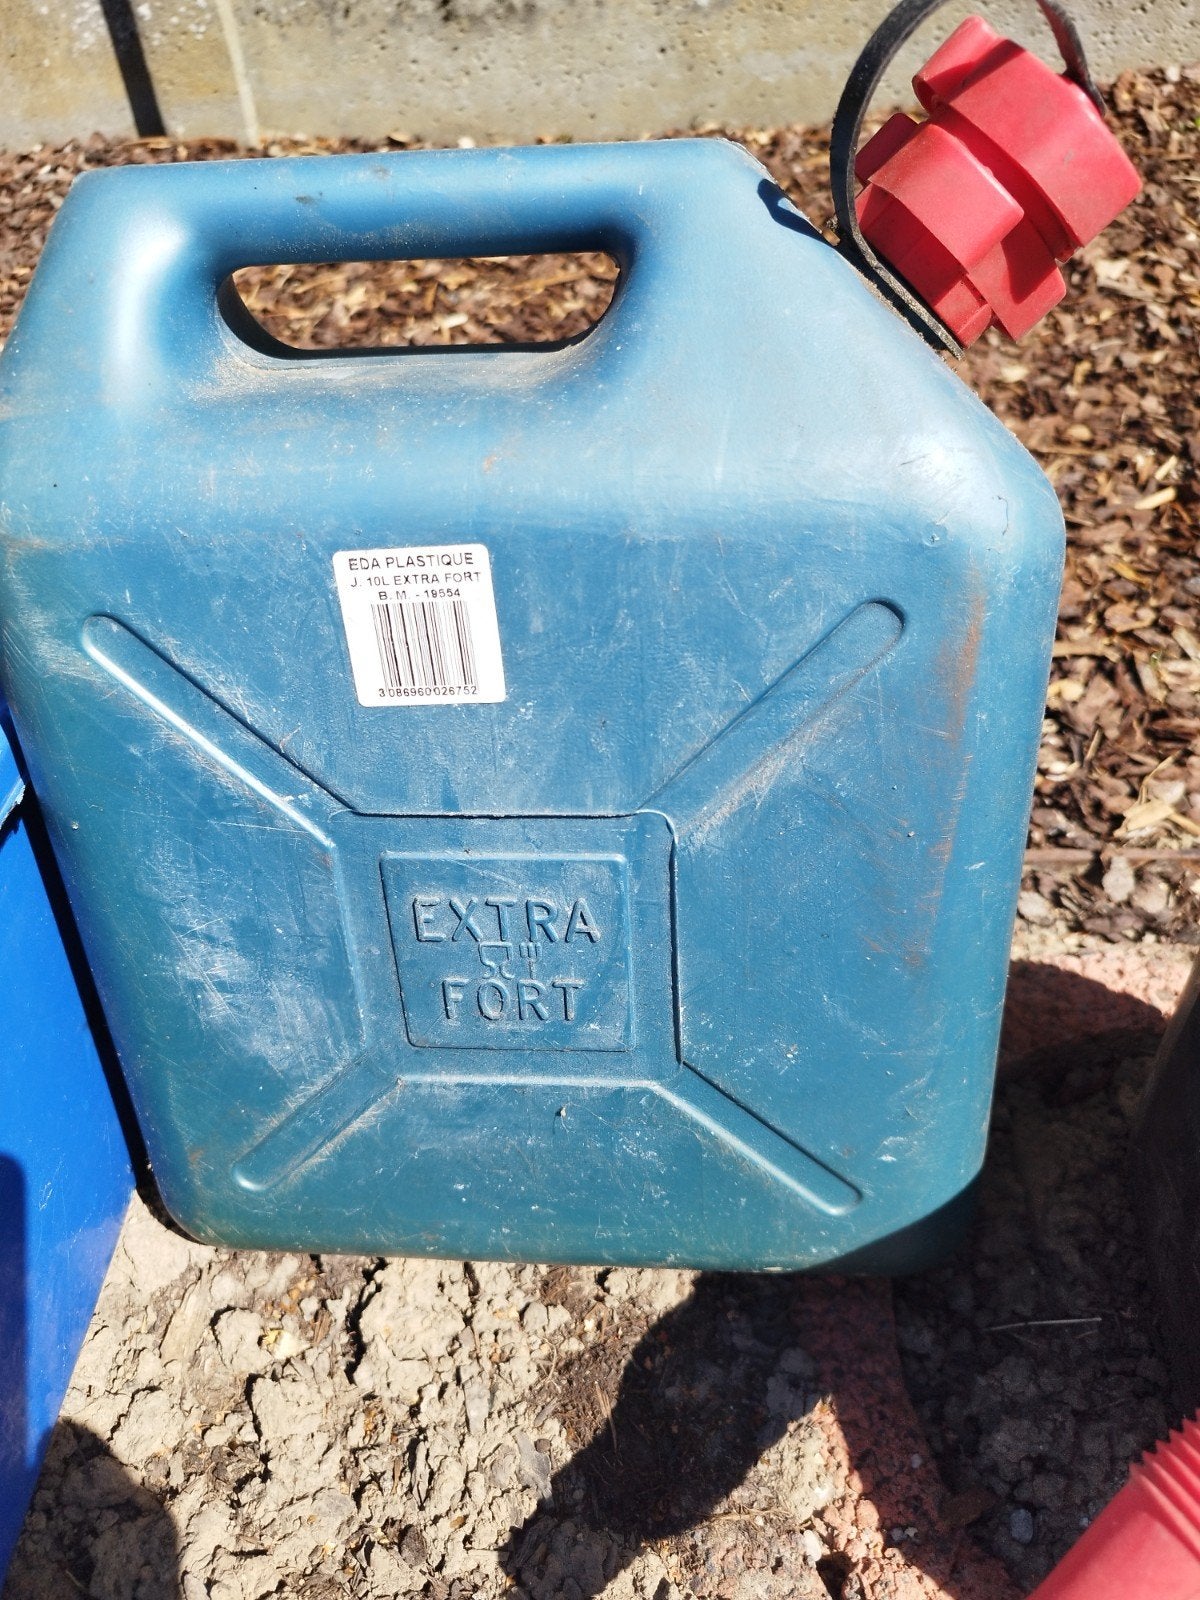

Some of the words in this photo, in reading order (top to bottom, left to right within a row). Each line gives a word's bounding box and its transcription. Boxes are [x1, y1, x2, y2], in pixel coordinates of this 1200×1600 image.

[348, 557, 381, 571] EDA
[386, 552, 475, 569] PLASTIQUE
[350, 578, 362, 588] J.
[367, 576, 390, 587] 10L
[393, 574, 440, 586] EXTRA
[445, 571, 482, 583] FORT
[411, 896, 601, 943] EXTRA
[441, 977, 586, 1021] FORT
